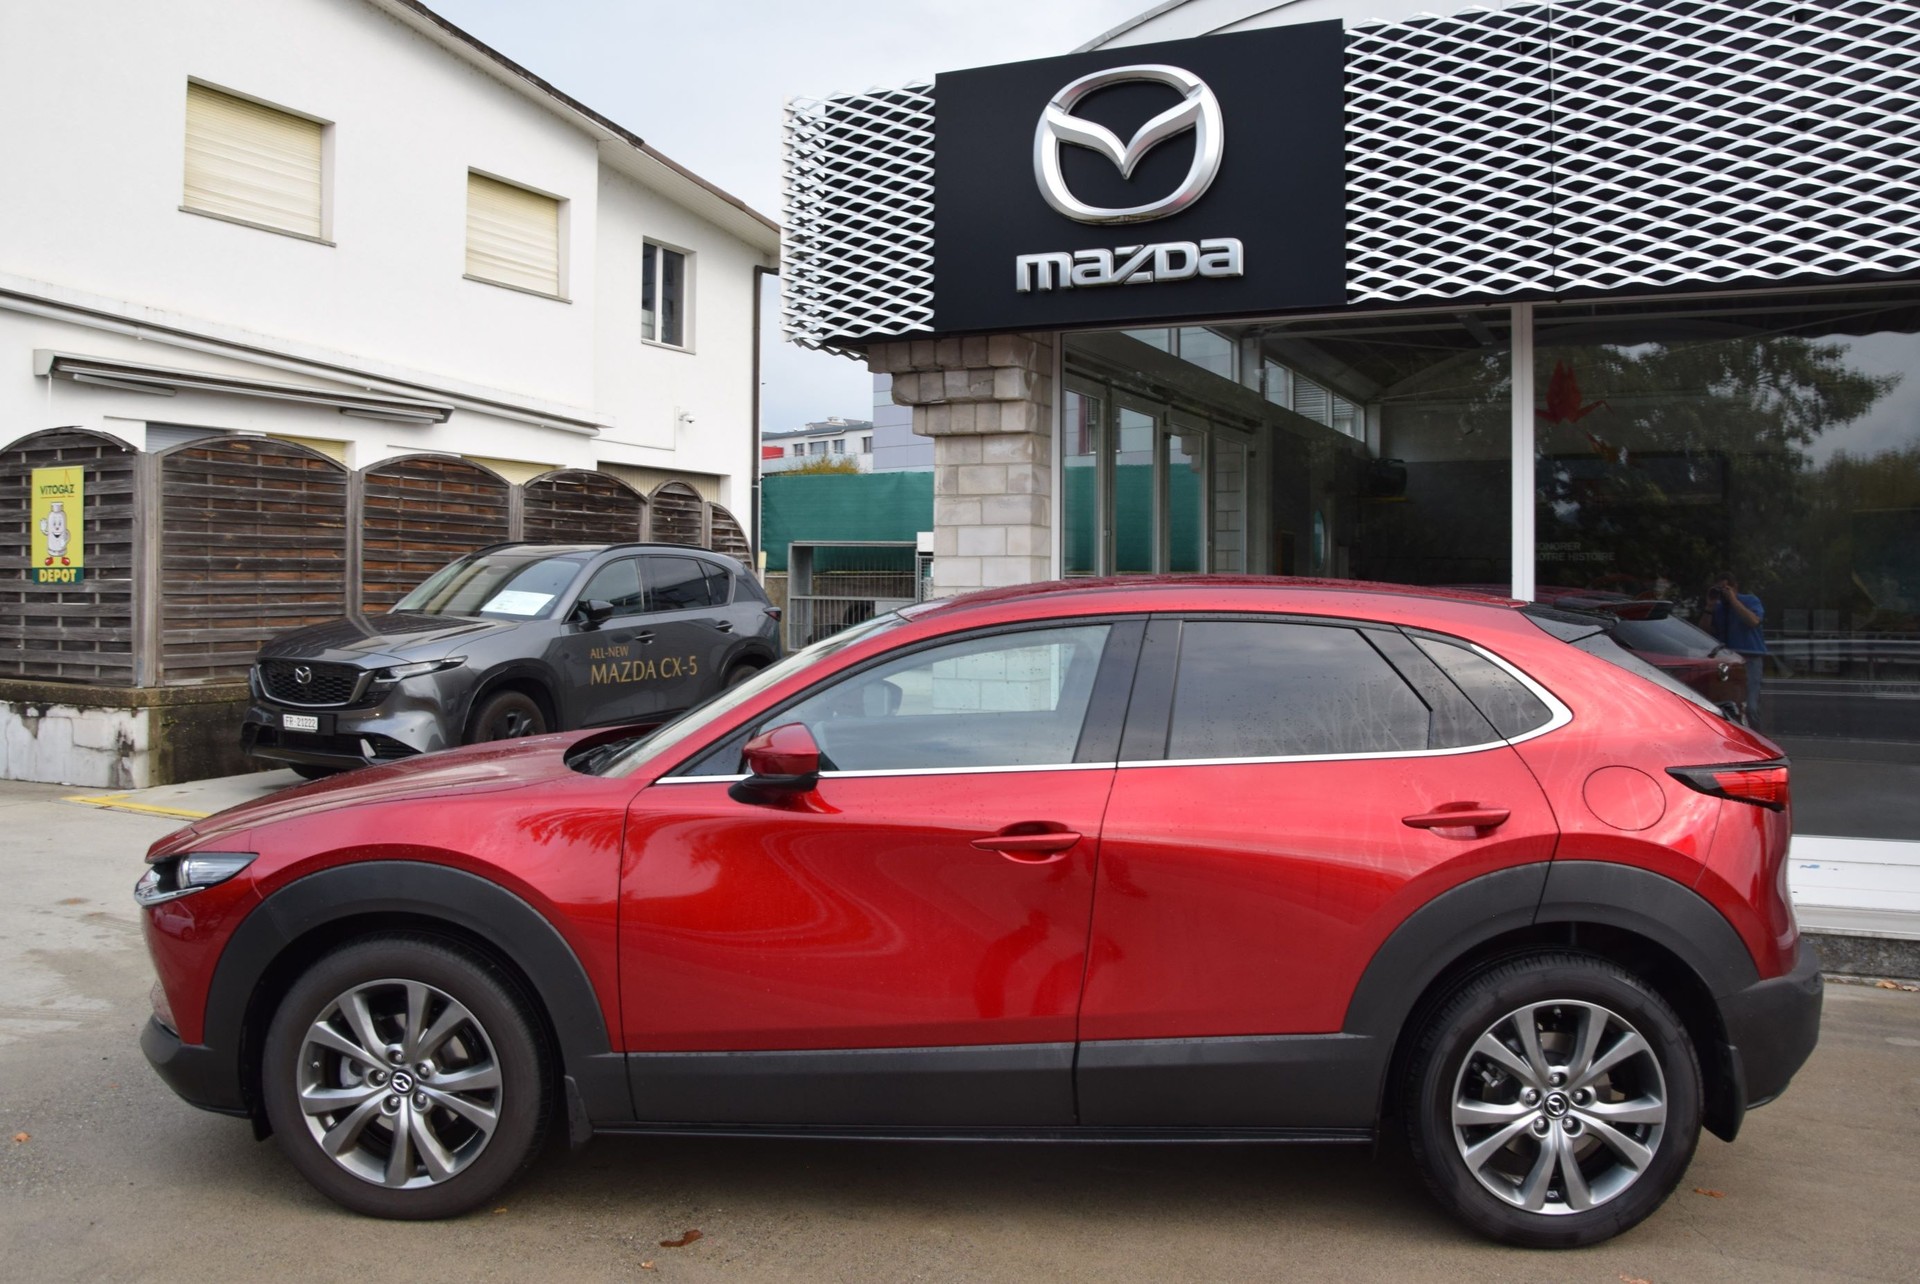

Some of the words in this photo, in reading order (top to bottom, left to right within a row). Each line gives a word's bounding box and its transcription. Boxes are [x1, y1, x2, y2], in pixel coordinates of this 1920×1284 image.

[1016, 238, 1244, 293] mazda
[40, 484, 75, 495] VITOGAZ
[1568, 552, 1616, 561] HISTOIRE
[39, 569, 76, 583] DEPOT
[590, 646, 629, 659] ALL-NEW
[591, 660, 657, 685] MAZDA
[660, 656, 698, 678] CX-5
